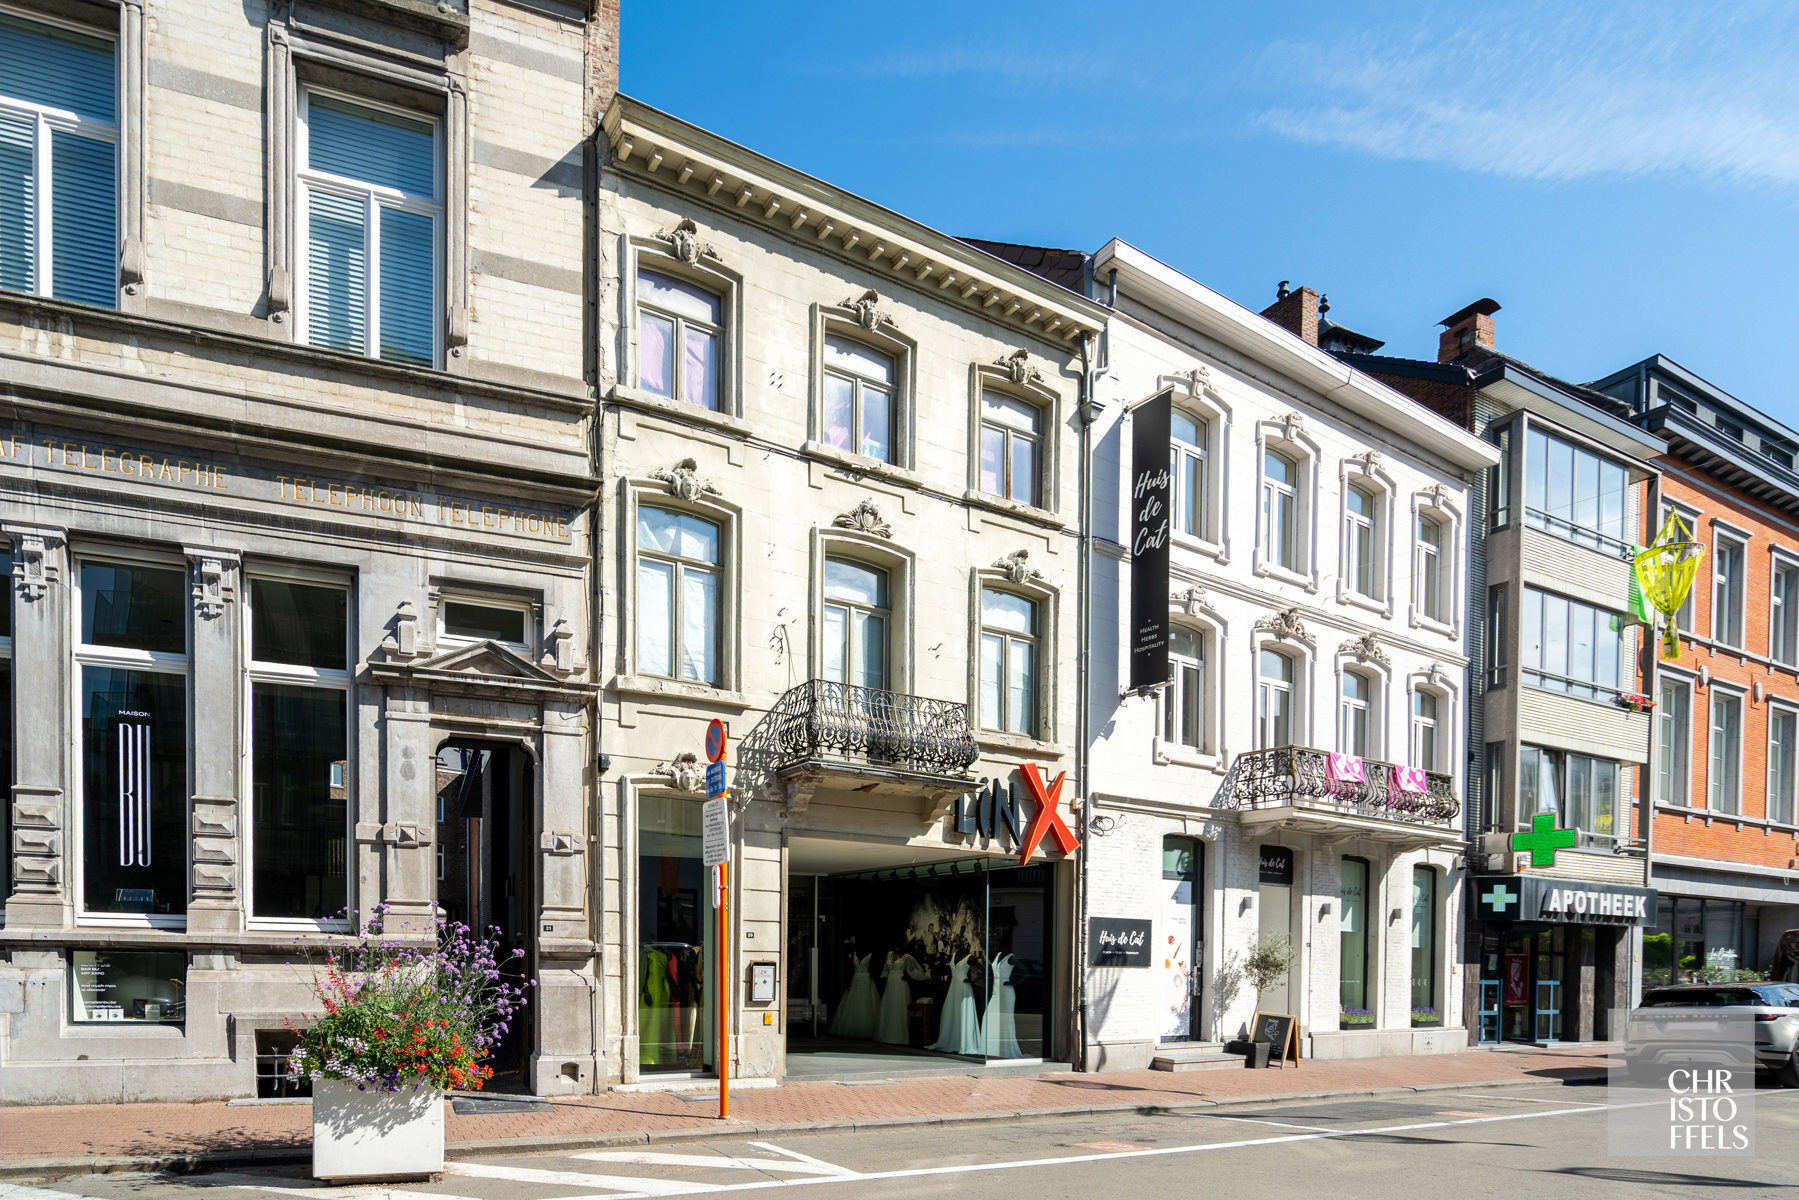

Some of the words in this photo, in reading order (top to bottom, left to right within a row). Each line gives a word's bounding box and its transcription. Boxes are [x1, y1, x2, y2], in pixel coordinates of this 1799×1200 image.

[43, 439, 228, 488] TELEGRAPHE
[276, 475, 423, 517] TELEPHOON
[435, 499, 569, 539] TELEPHONE
[1134, 468, 1171, 499] Huis
[1138, 495, 1163, 522] de
[1133, 518, 1168, 556] Cat
[118, 709, 151, 717] MAISON
[118, 722, 152, 867] BU
[1549, 888, 1647, 918] APOTHEEK
[1099, 930, 1117, 946] Huis
[1117, 931, 1129, 945] de
[1129, 930, 1145, 947] Cat
